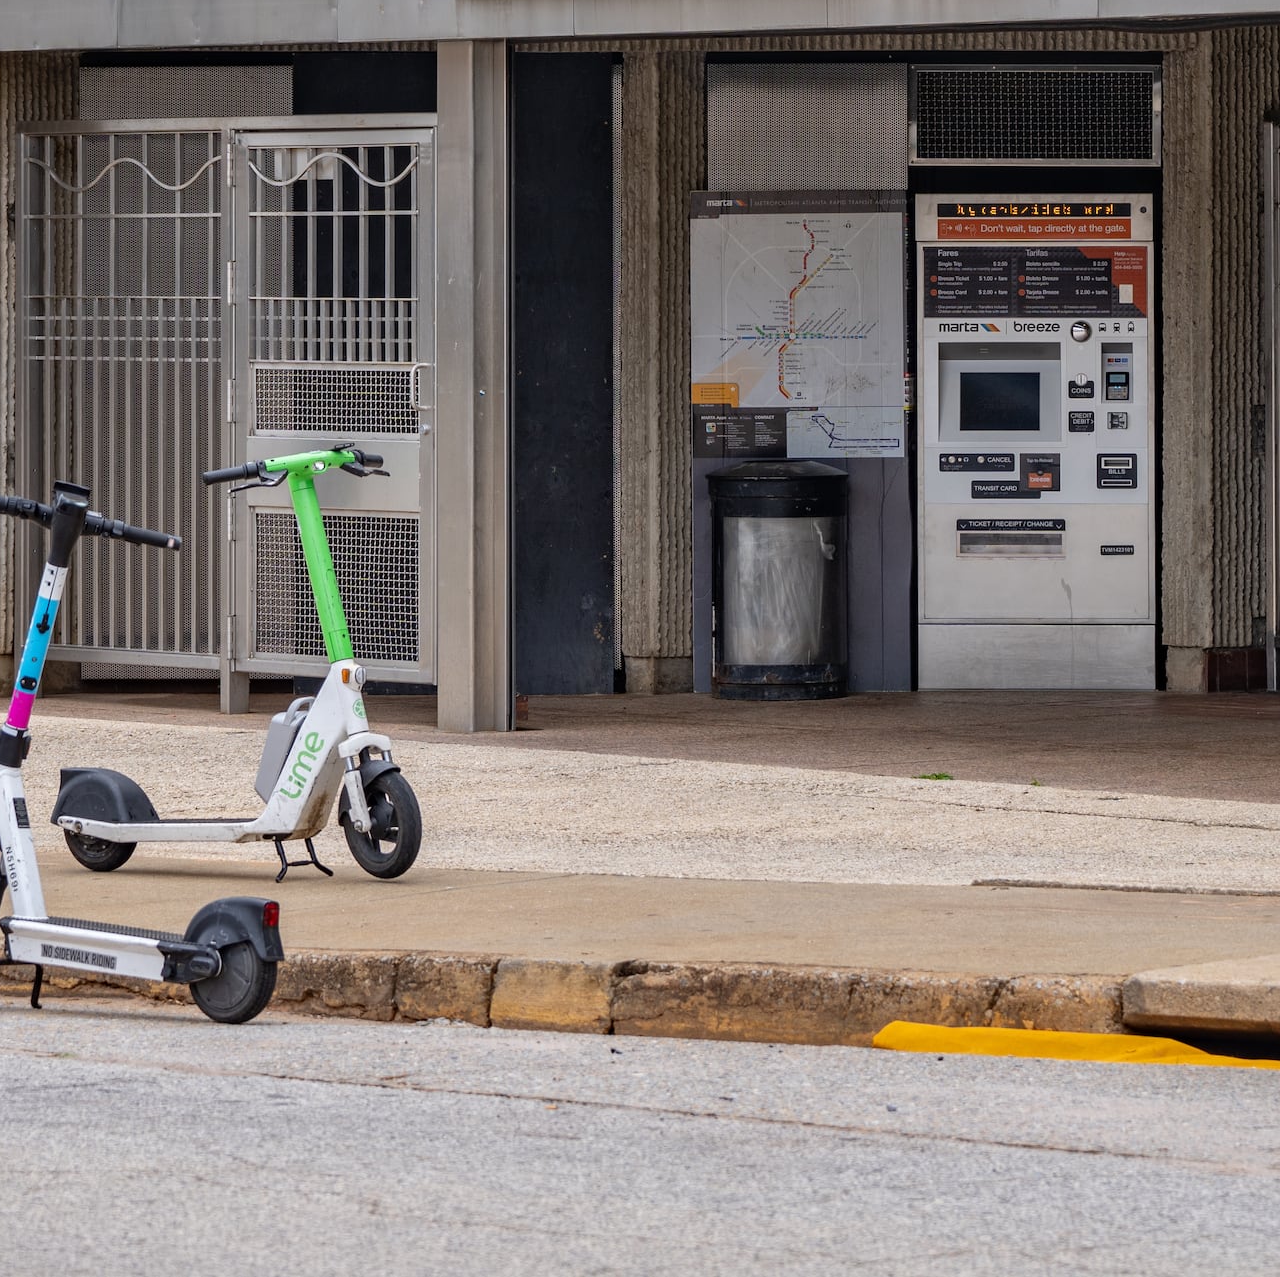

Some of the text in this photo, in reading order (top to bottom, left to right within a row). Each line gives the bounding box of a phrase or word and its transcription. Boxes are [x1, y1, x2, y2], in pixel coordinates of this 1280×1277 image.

[706, 199, 733, 207] marta
[980, 224, 1126, 235] Don't wait, tap directly at the gate.
[938, 250, 959, 258] Fares
[938, 322, 979, 333] marta
[1013, 321, 1061, 333] breeze
[41, 943, 116, 970] NO SIDEWALK RIDING
